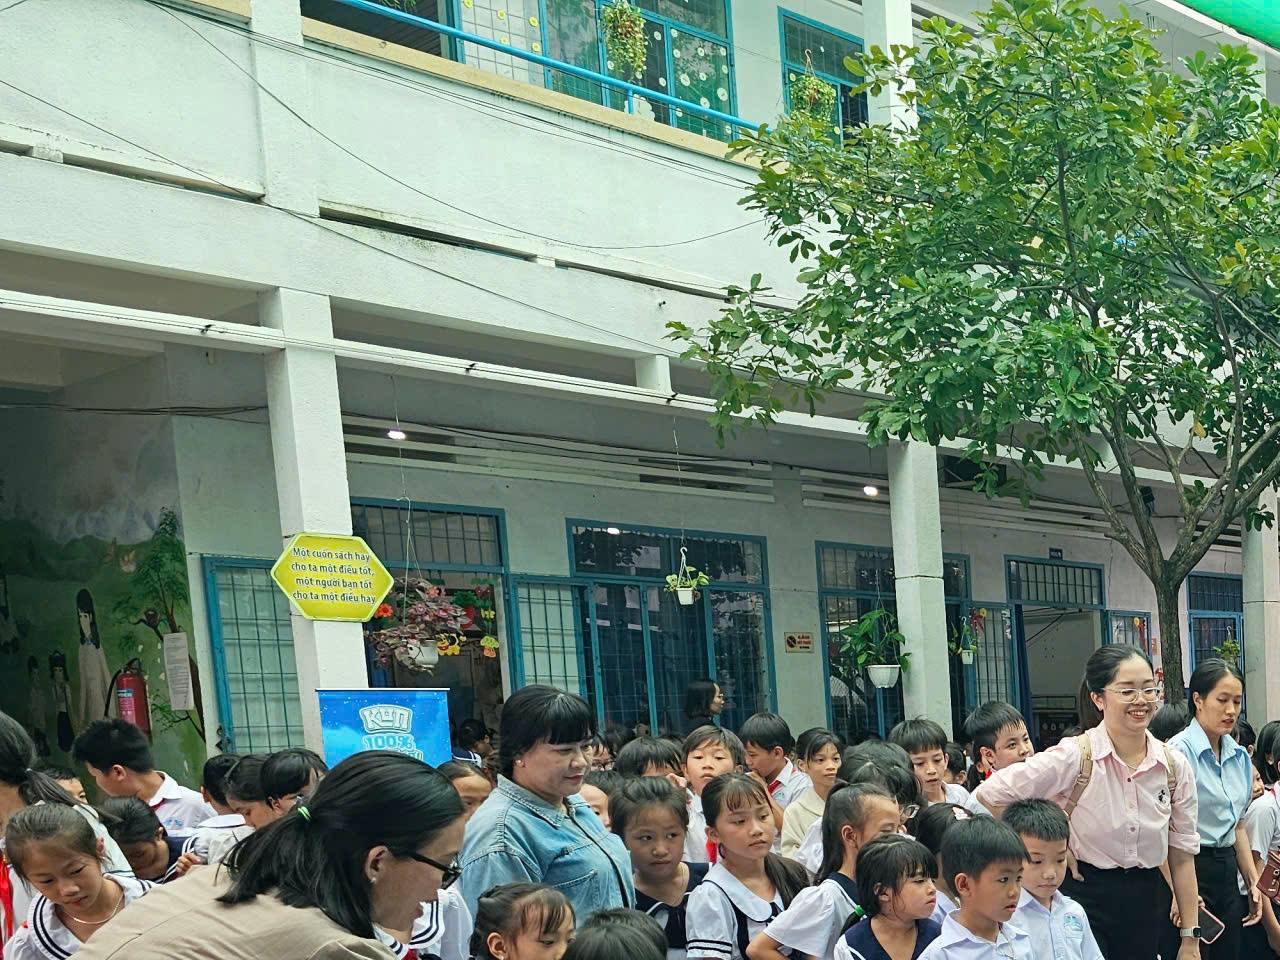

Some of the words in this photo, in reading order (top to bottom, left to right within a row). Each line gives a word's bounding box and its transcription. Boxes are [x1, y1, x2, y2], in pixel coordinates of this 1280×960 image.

[293, 547, 310, 559] Một
[335, 550, 353, 560] sách
[355, 552, 370, 562] hay
[292, 562, 306, 571] cho
[308, 563, 318, 572] ta
[320, 563, 337, 574] một
[296, 576, 313, 588] một
[315, 577, 341, 588] người
[342, 579, 358, 590] bạn
[293, 590, 308, 600] cho
[310, 592, 319, 600] ta
[320, 592, 338, 603] một
[361, 594, 376, 604] hay
[364, 735, 414, 750] 100%
